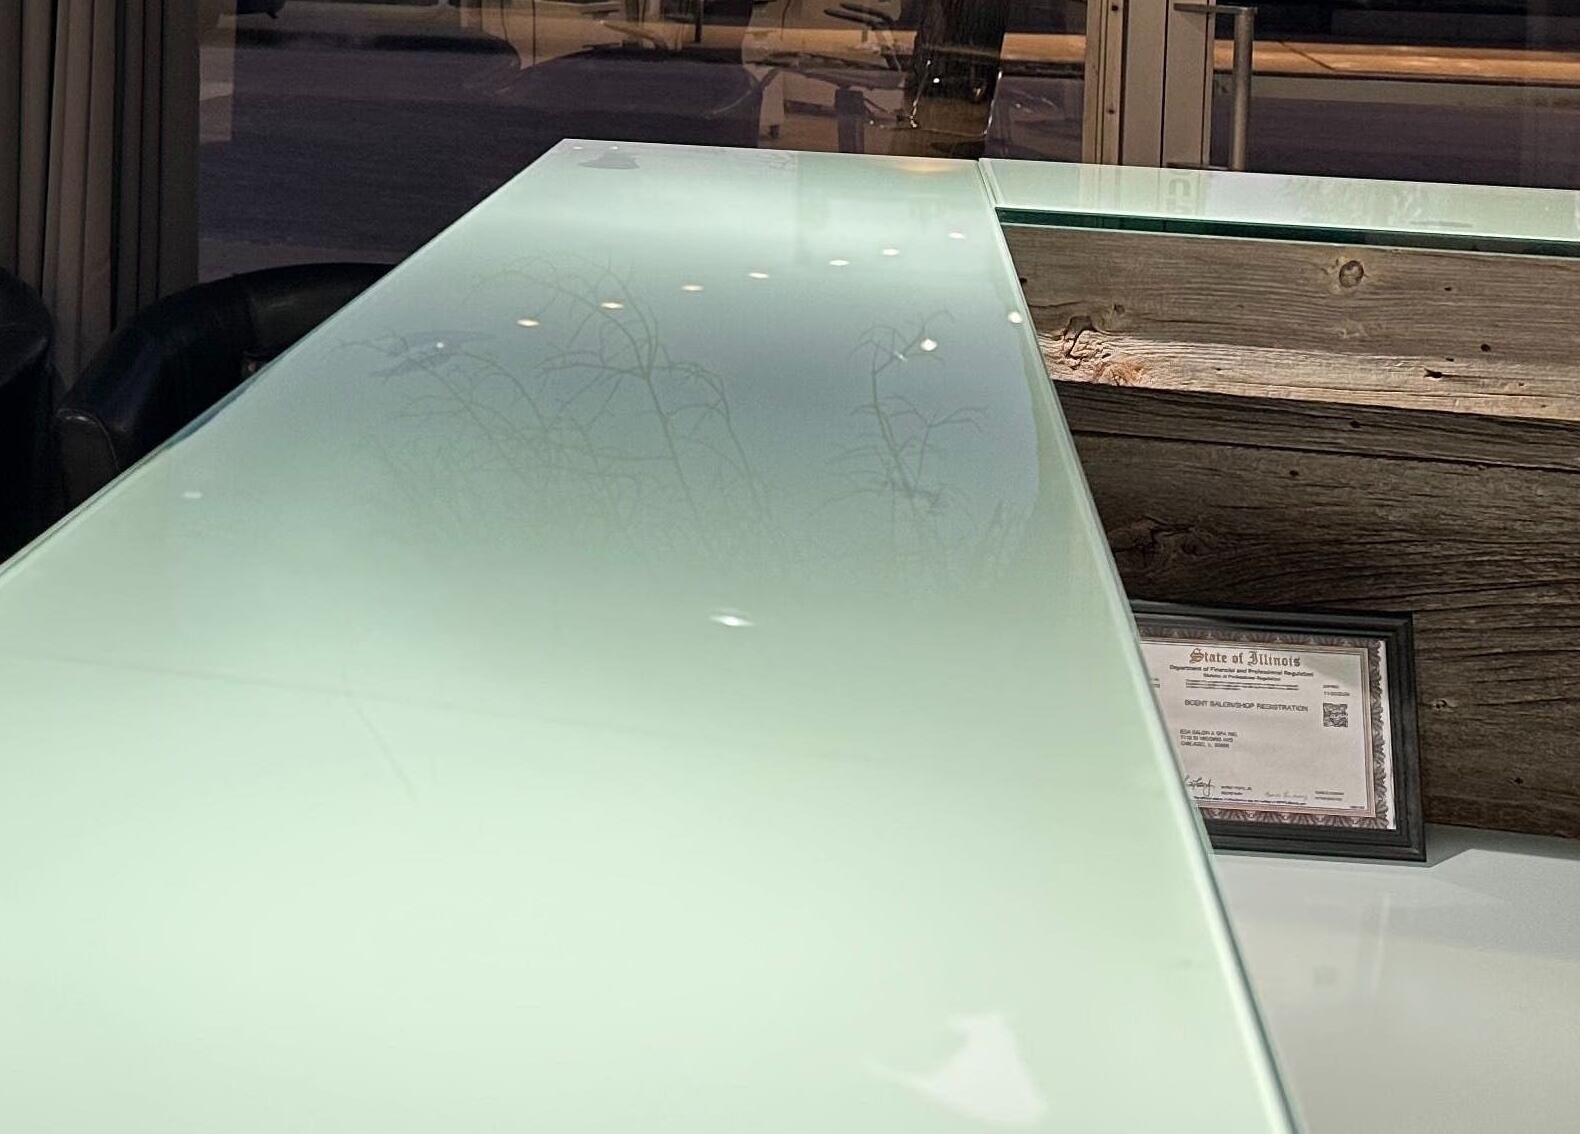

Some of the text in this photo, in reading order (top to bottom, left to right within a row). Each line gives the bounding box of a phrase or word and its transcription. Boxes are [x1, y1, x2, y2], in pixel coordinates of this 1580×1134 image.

[1189, 648, 1301, 667] State of Illinois
